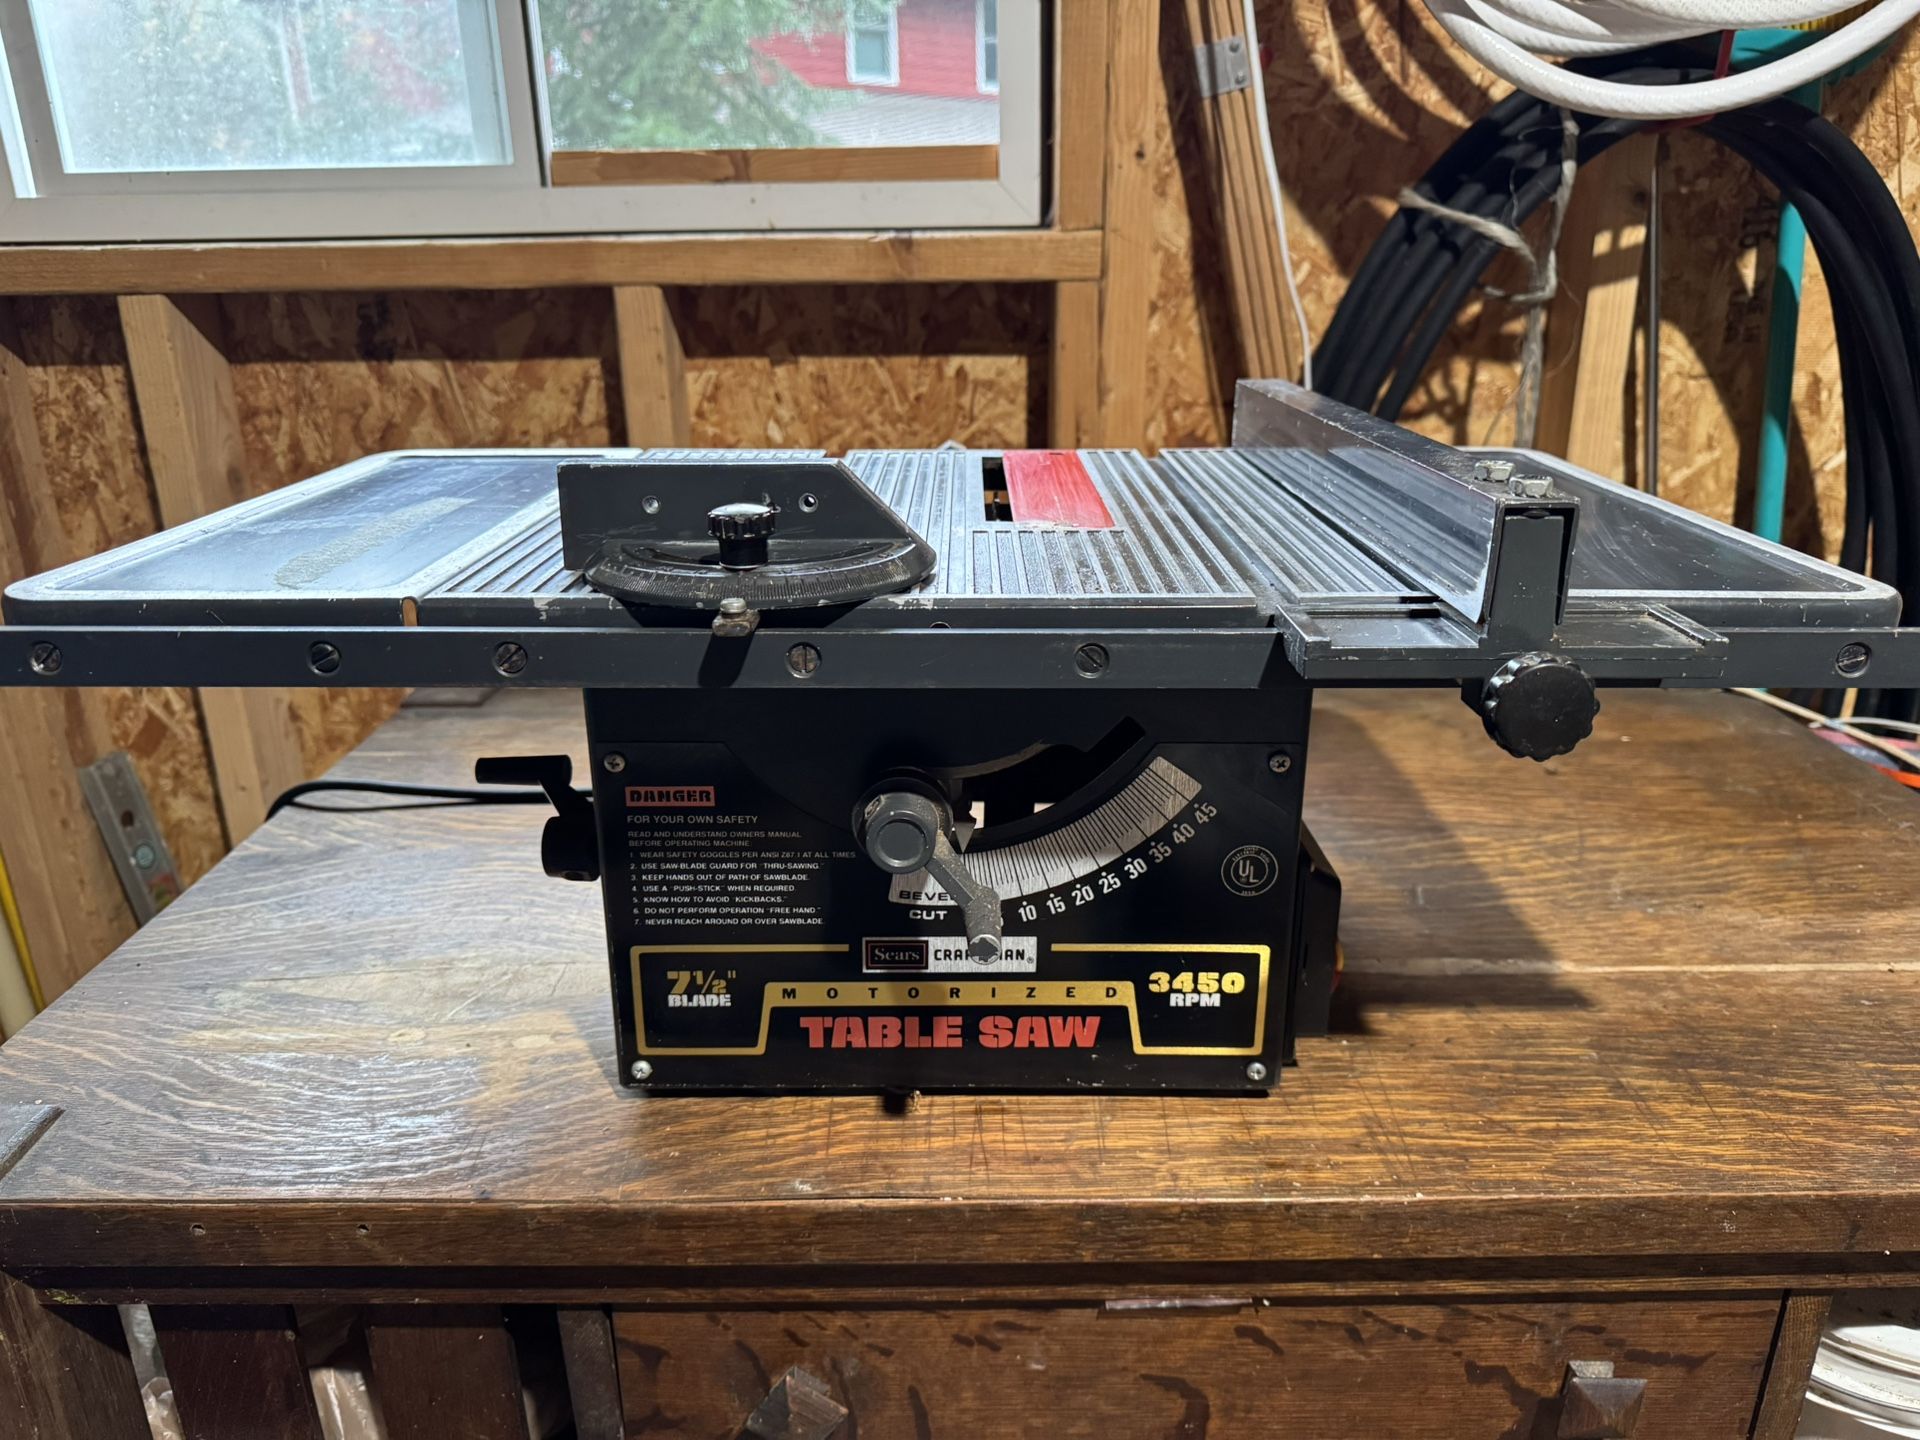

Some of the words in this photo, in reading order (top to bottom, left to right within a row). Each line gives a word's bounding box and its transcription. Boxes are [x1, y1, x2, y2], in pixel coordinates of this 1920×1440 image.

[629, 790, 712, 803] DANGER
[627, 815, 650, 824] FOR
[654, 815, 684, 824] YOUR
[687, 815, 714, 824] OWN
[716, 815, 758, 824] SAFETY
[640, 851, 664, 859] WEAR
[667, 851, 697, 859] SAFETY
[700, 851, 740, 859] GOGGLES
[741, 851, 758, 859] PER
[760, 851, 779, 859] ANSI
[802, 851, 813, 859] AT
[815, 851, 829, 859] ALL
[641, 862, 658, 870] USE
[709, 862, 739, 870] GUARD
[740, 862, 757, 870] FOR
[1018, 903, 1037, 922] 10
[1046, 896, 1066, 915] 15
[1071, 884, 1095, 906] 20
[1098, 872, 1122, 894] 25
[1124, 857, 1148, 879] 30
[1148, 841, 1172, 863] 35
[1172, 822, 1195, 845] 40
[1194, 802, 1218, 825] 45
[642, 873, 664, 881] KEEP
[666, 873, 694, 881] HANDS
[696, 873, 713, 881] OUT
[715, 873, 726, 881] OF
[728, 873, 748, 881] PATH
[750, 873, 761, 881] OF
[1238, 859, 1260, 883] UL
[899, 890, 953, 901] BEVE
[909, 910, 948, 920] CUT
[874, 947, 920, 961] Sears
[1148, 971, 1246, 994] 3450
[782, 987, 1118, 999] MOTORIZED
[667, 994, 732, 1007] BLADE
[1169, 993, 1221, 1007] RPM
[800, 1016, 963, 1048] TABLE
[978, 1015, 1101, 1048] SAW
